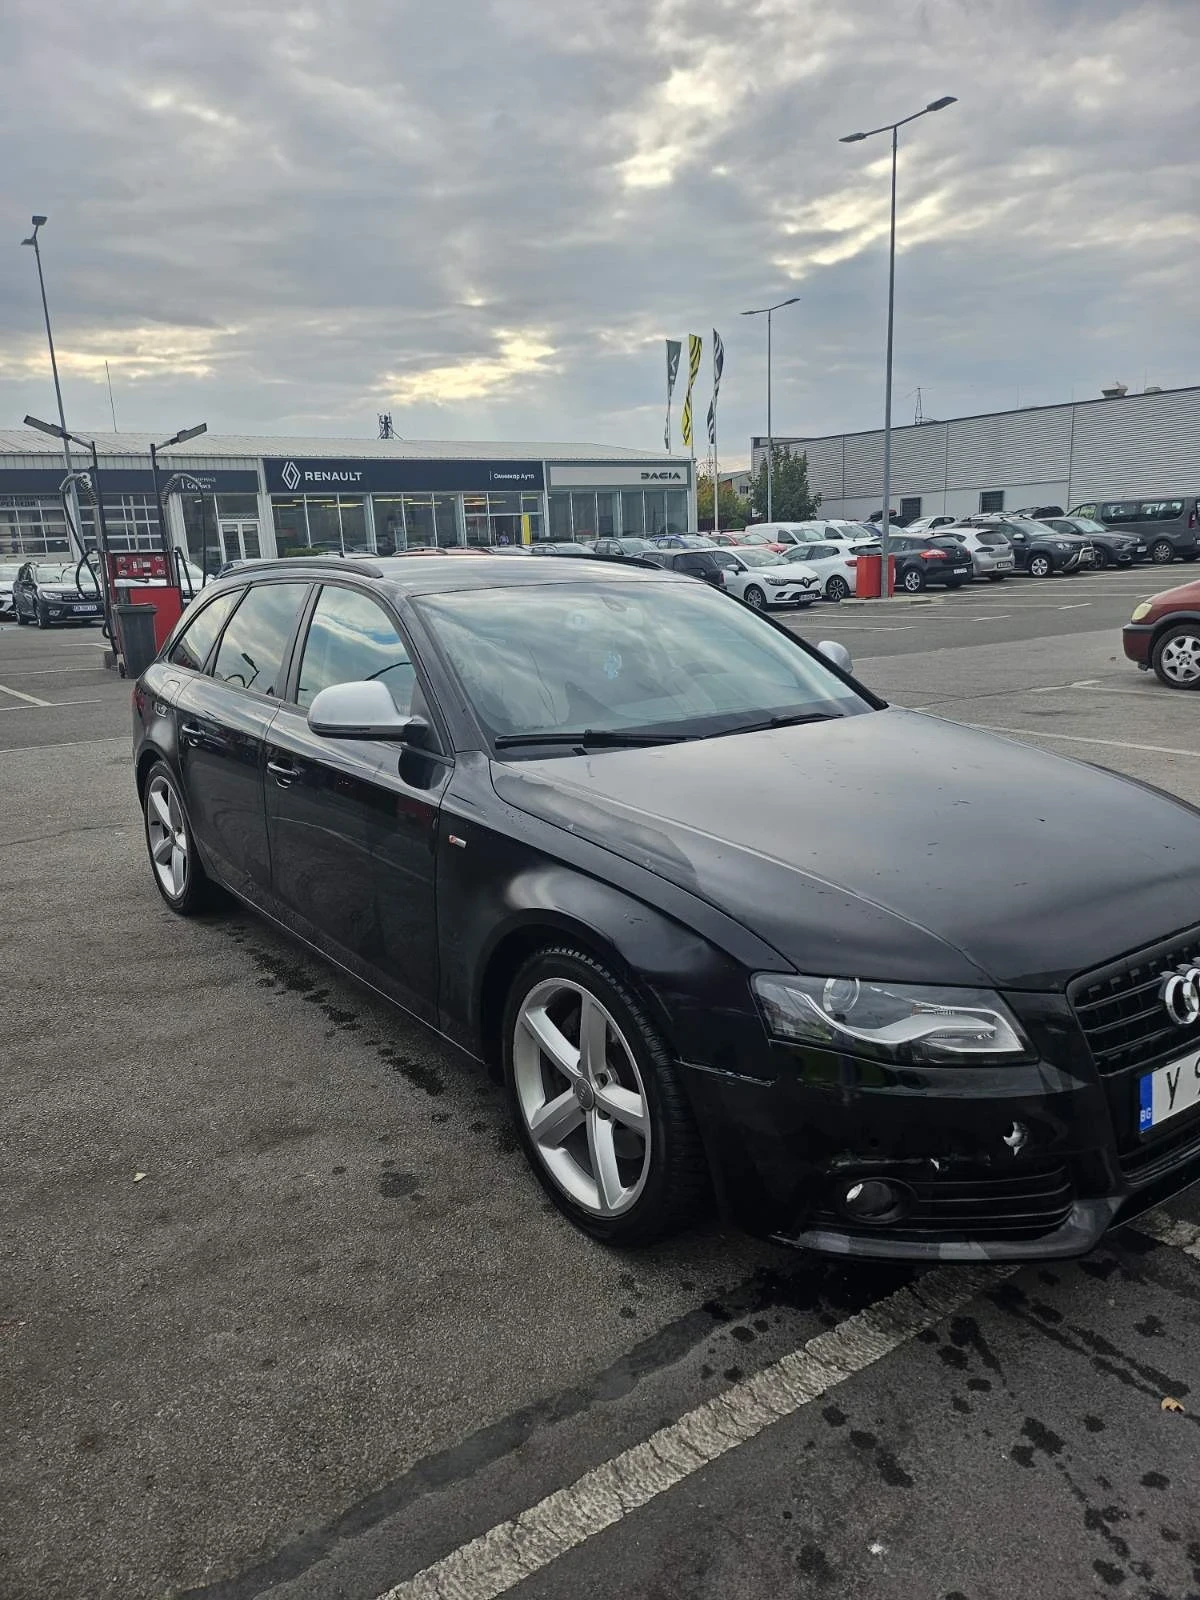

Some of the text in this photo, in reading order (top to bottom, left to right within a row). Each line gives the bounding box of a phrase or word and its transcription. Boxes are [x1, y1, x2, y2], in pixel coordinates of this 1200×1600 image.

[304, 471, 363, 481] RENAULT
[640, 472, 681, 480] DACIA
[1140, 1107, 1152, 1123] BG
